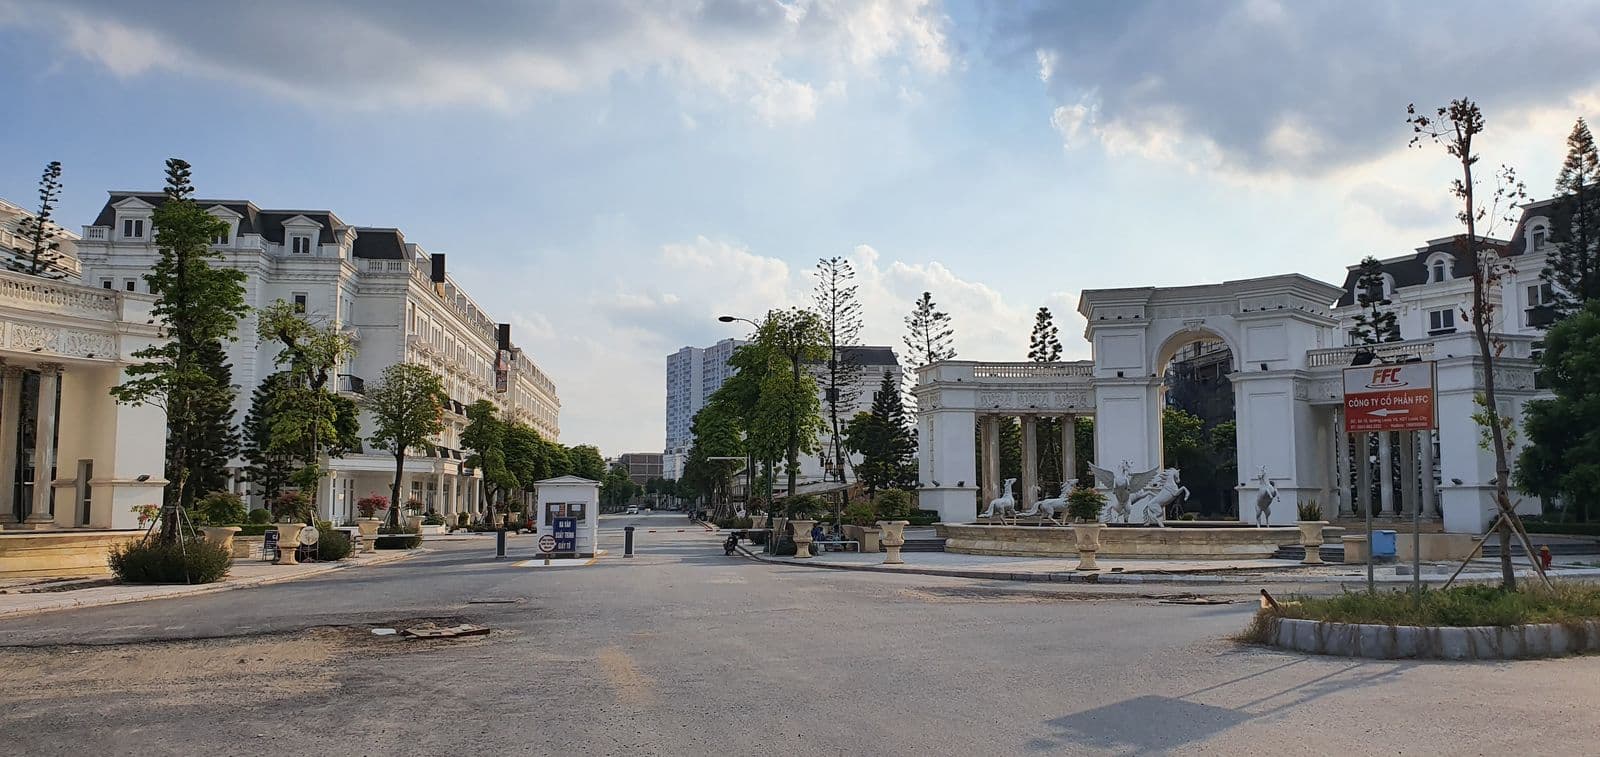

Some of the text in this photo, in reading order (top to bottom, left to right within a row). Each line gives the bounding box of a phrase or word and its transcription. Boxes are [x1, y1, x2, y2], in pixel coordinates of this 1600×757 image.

[1372, 368, 1401, 383] FFC
[1348, 397, 1370, 407] CÔNG
[1415, 395, 1429, 404] FFC
